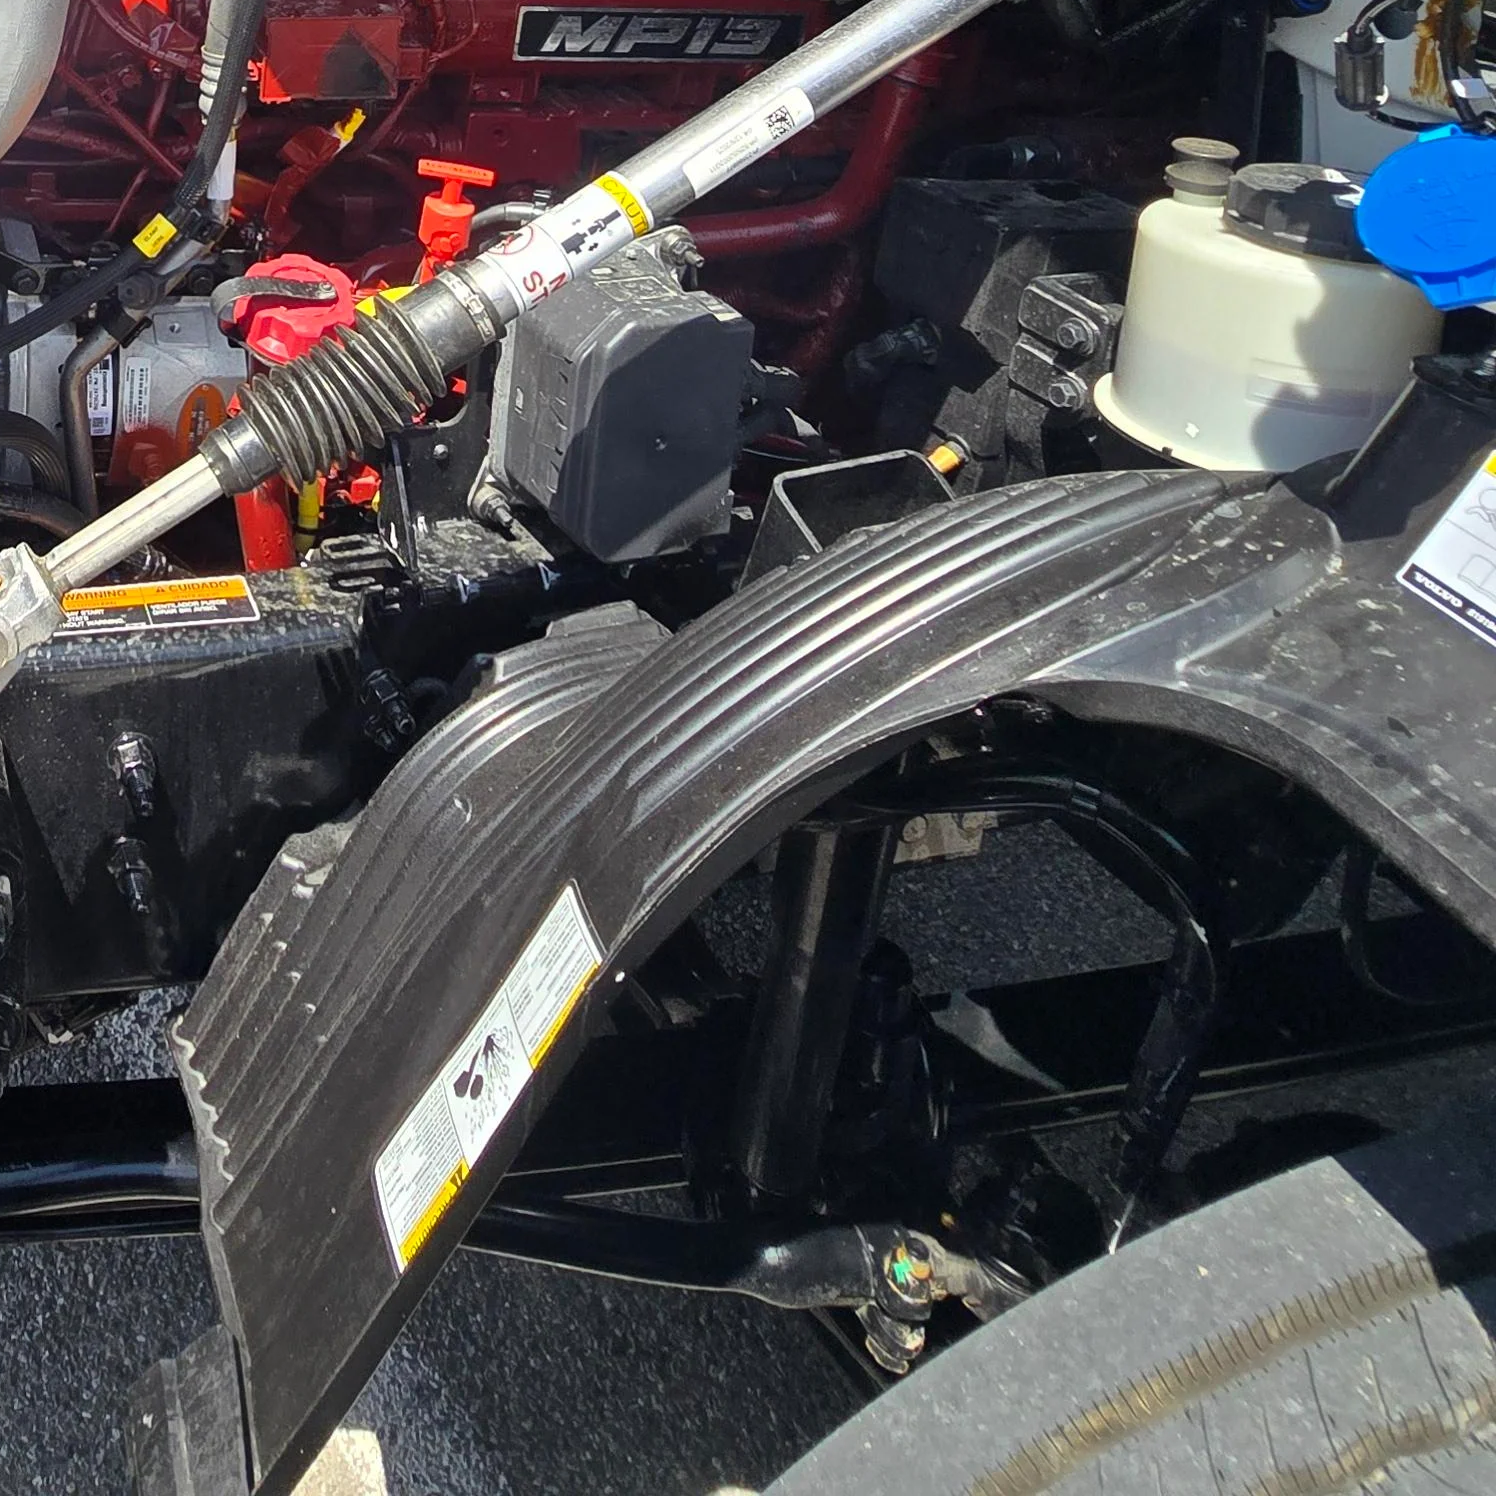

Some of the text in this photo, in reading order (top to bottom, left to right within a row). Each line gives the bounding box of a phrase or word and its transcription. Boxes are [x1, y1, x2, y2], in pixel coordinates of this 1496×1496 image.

[540, 14, 783, 54] MP13
[62, 589, 128, 601] WARNING
[167, 580, 230, 593] CUIDADO
[1415, 571, 1463, 608] VOLVO
